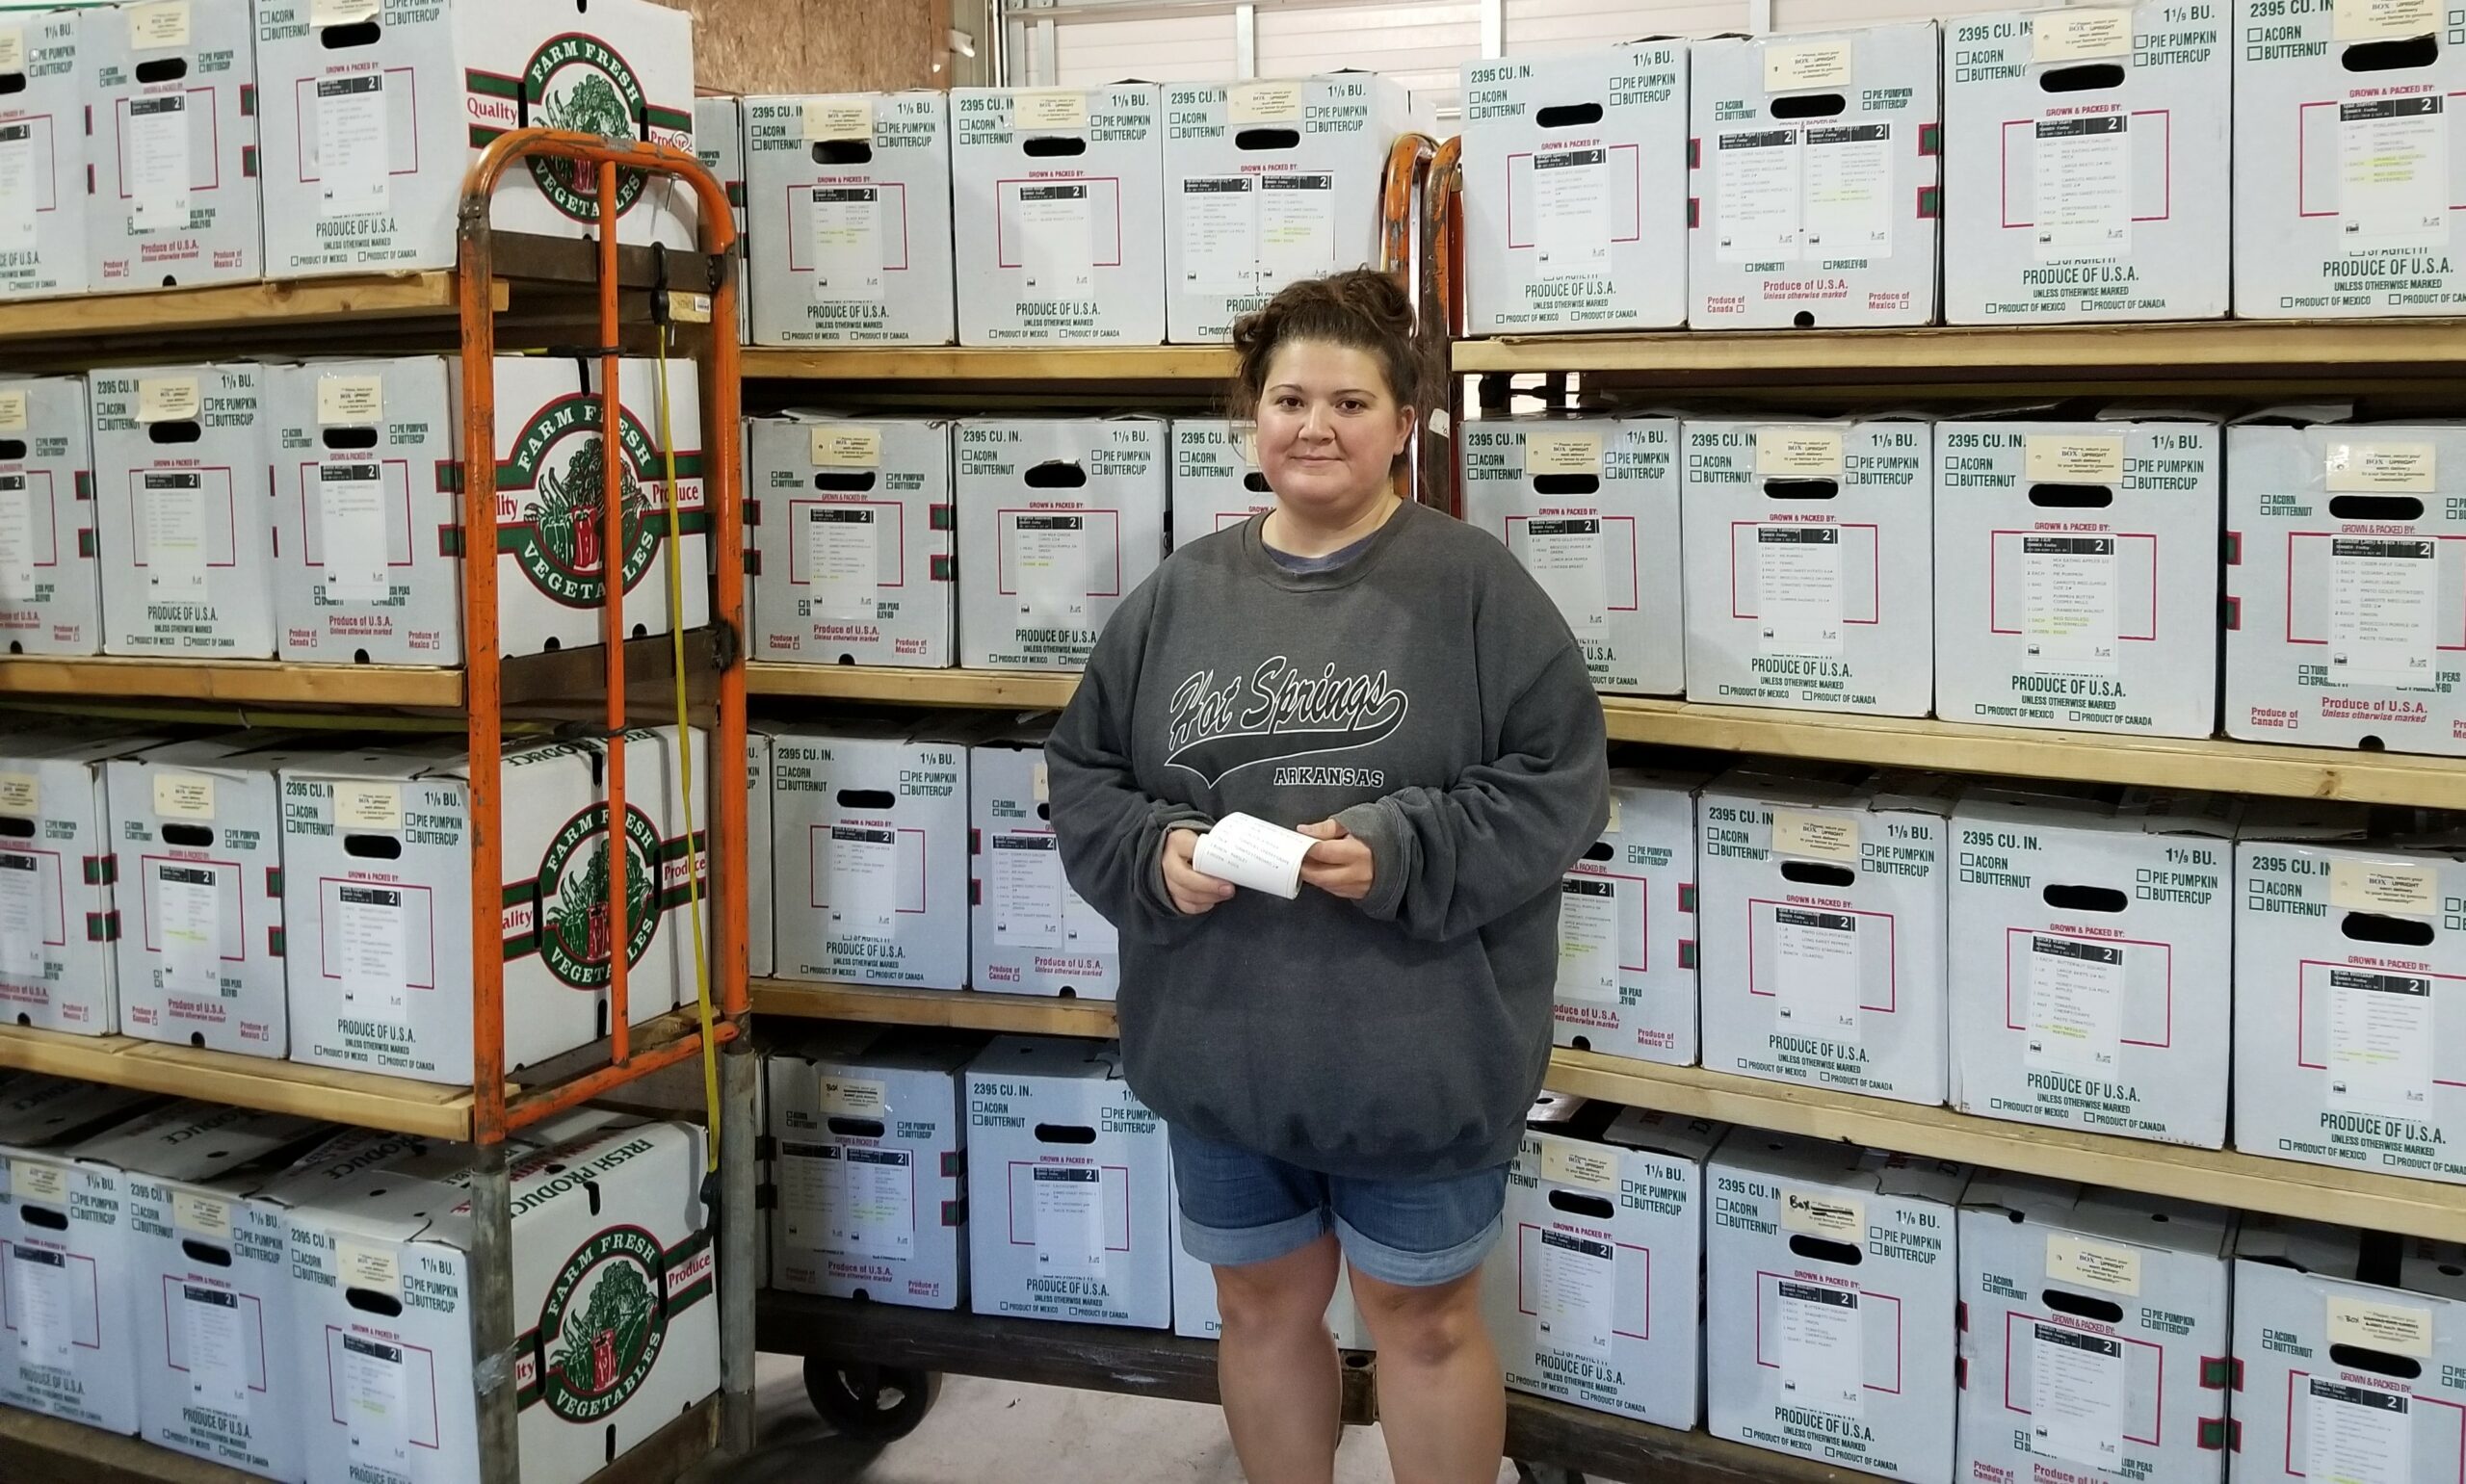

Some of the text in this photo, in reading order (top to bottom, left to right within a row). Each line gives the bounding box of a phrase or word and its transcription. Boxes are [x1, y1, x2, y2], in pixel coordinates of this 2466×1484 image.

[271, 11, 294, 23] ACORN
[397, 9, 439, 26] BUTTERCUP
[272, 24, 310, 40] BUTTERNUT
[2265, 25, 2301, 41] ACORN
[1655, 51, 1674, 65] BU.
[2150, 49, 2211, 66] BUTTERCUP
[2265, 41, 2327, 61] BUTTERNUT
[39, 61, 73, 75] BUTTERCUP
[532, 40, 639, 103] FARM FRESH
[1471, 65, 1534, 83] 2395 CU. IN.
[1623, 74, 1676, 89] PIE PUMPKIN
[1482, 90, 1508, 102] ACORN
[1623, 90, 1671, 105] BUTTERCUP
[467, 97, 517, 123] Quality
[1318, 106, 1367, 117] PIE PUMPKIN
[1482, 103, 1526, 118] BUTTERNUT
[1182, 113, 1207, 124] ACORN
[888, 122, 935, 134] PIE PUMPKIN
[1182, 126, 1224, 138] BUTTERNUT
[888, 136, 931, 147] BUTTERCUP
[1570, 140, 1591, 148] PACKED
[1590, 151, 1599, 162] 2
[535, 159, 641, 217] VEGETALES
[317, 218, 398, 237] PRODUCE OF U.S.A.
[1755, 263, 1785, 272] SPAGHETTI
[2023, 266, 2139, 285] PRODUCE OF U.S.A.
[1526, 281, 1616, 298] PRODUCE OF U.S.A.
[1764, 279, 1849, 291] Produce of U.S.A.
[1787, 291, 1820, 299] otherwise
[1016, 302, 1100, 316] PRODUCE OF U.S.A.
[1555, 299, 1585, 308] OTHERWISE
[1587, 299, 1608, 307] MARKED
[1539, 313, 1559, 322] MEXICO
[1615, 310, 1638, 319] CANADA
[517, 404, 652, 472] FARM FESH
[963, 430, 1022, 442] 2395 CU. IN.
[973, 451, 998, 461] ACORN
[1617, 453, 1669, 464] PIE PUMPKIN
[1703, 456, 1732, 468] ACORN
[974, 463, 1014, 475] BUTTERNUT
[1104, 464, 1146, 476] BUTTERCUP
[1617, 467, 1665, 479] BUTTERCUP
[1703, 471, 1752, 483] BUTTERNUT
[1584, 521, 1591, 531] 2
[2095, 540, 2104, 552] 2
[524, 532, 654, 599] VEGETALES
[147, 606, 219, 621] PRODUCE OF U.S.A.
[1751, 659, 1852, 677] PRODUCE OF U.S.A.
[1168, 656, 1388, 751] Hot Springs
[2322, 696, 2427, 714] Produce of U.S.A.
[778, 748, 834, 761] 2395 CU. IN.
[1273, 767, 1384, 787] ARKANSAS
[911, 784, 953, 796] BUTTERCUP
[296, 806, 318, 819] ACORN
[417, 814, 462, 830] PIE PUMPKIN
[417, 831, 459, 846] BUTTERCUP
[546, 810, 654, 872] FARM FESH
[1963, 831, 2042, 851] 2395 CU. IN.
[1876, 846, 1935, 863] PIE PUMPKIN
[1976, 855, 2008, 870] ACORN
[665, 857, 706, 880] Prodce
[1976, 872, 2032, 889] BUTTERNUT
[2266, 882, 2302, 898] ACORN
[2266, 899, 2327, 917] BUTTERNUT
[551, 918, 653, 983] VEGETLES
[973, 1083, 1033, 1098] 2395 CU. IN.
[2028, 1073, 2140, 1103] PRODUCE OF U.S.A.
[984, 1102, 1009, 1114] ACORN
[984, 1115, 1026, 1128] BUTTERNUT
[511, 1138, 655, 1219] FRESH PRODUC
[1634, 1182, 1687, 1202] PIE PUMPKIN
[1634, 1196, 1682, 1216] BUTTERCUP
[1729, 1200, 1758, 1217] ACORN
[142, 1220, 173, 1239] BUTTERNUT
[1728, 1214, 1778, 1236] BUTTERNUT
[547, 1233, 656, 1317] FARM FRESH
[668, 1253, 711, 1289] Produce
[413, 1277, 459, 1299] PIE PUMPKIN
[414, 1293, 456, 1315] BUTTERCUP
[557, 1331, 662, 1418] VEGETABLES
[2341, 1372, 2366, 1385] GROWN
[2374, 1378, 2400, 1392] PACKED
[1774, 1407, 1876, 1443] PRODUCE OF U.S.A.
